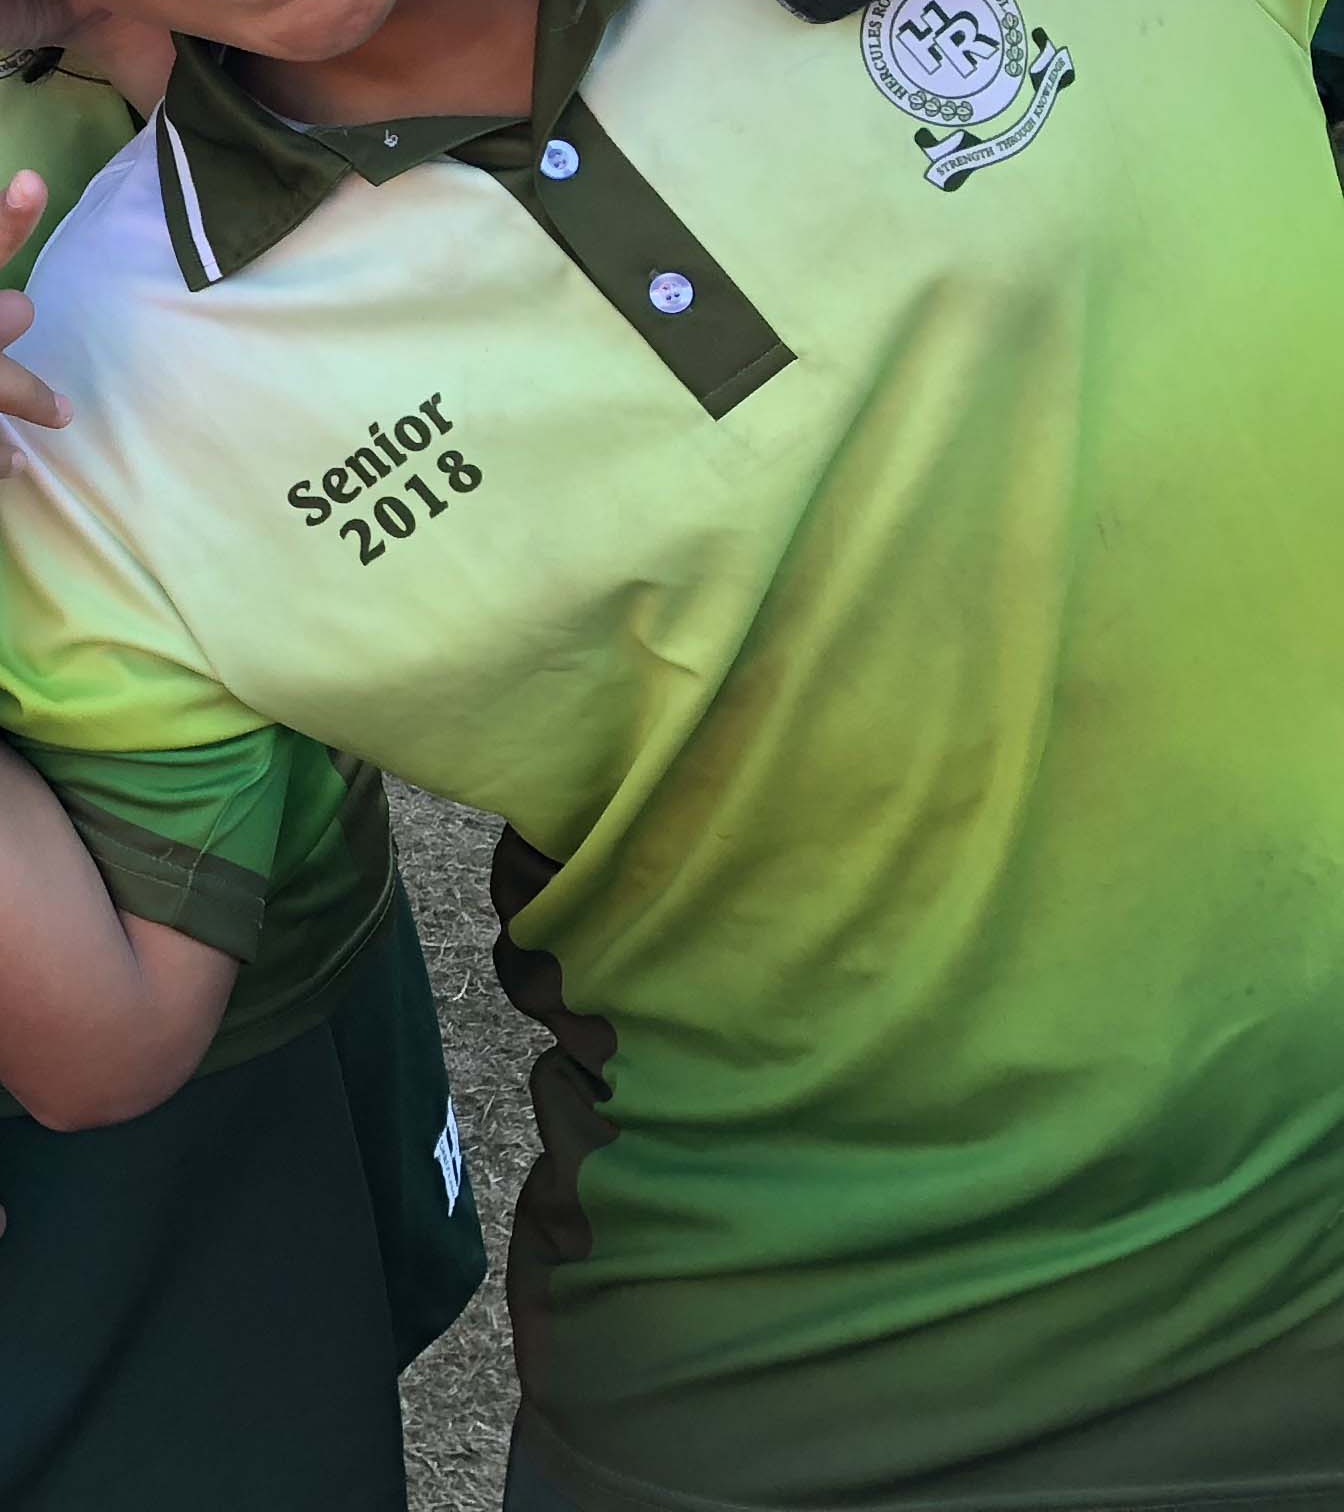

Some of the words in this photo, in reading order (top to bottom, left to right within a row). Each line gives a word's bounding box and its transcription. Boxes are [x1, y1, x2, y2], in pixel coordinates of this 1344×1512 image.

[868, 19, 906, 101] HERCULES
[896, 0, 1001, 79] HR
[936, 145, 996, 176] STRENGTH
[995, 117, 1037, 152] THROUGH
[287, 391, 454, 527] Senior
[339, 449, 483, 567] 2018
